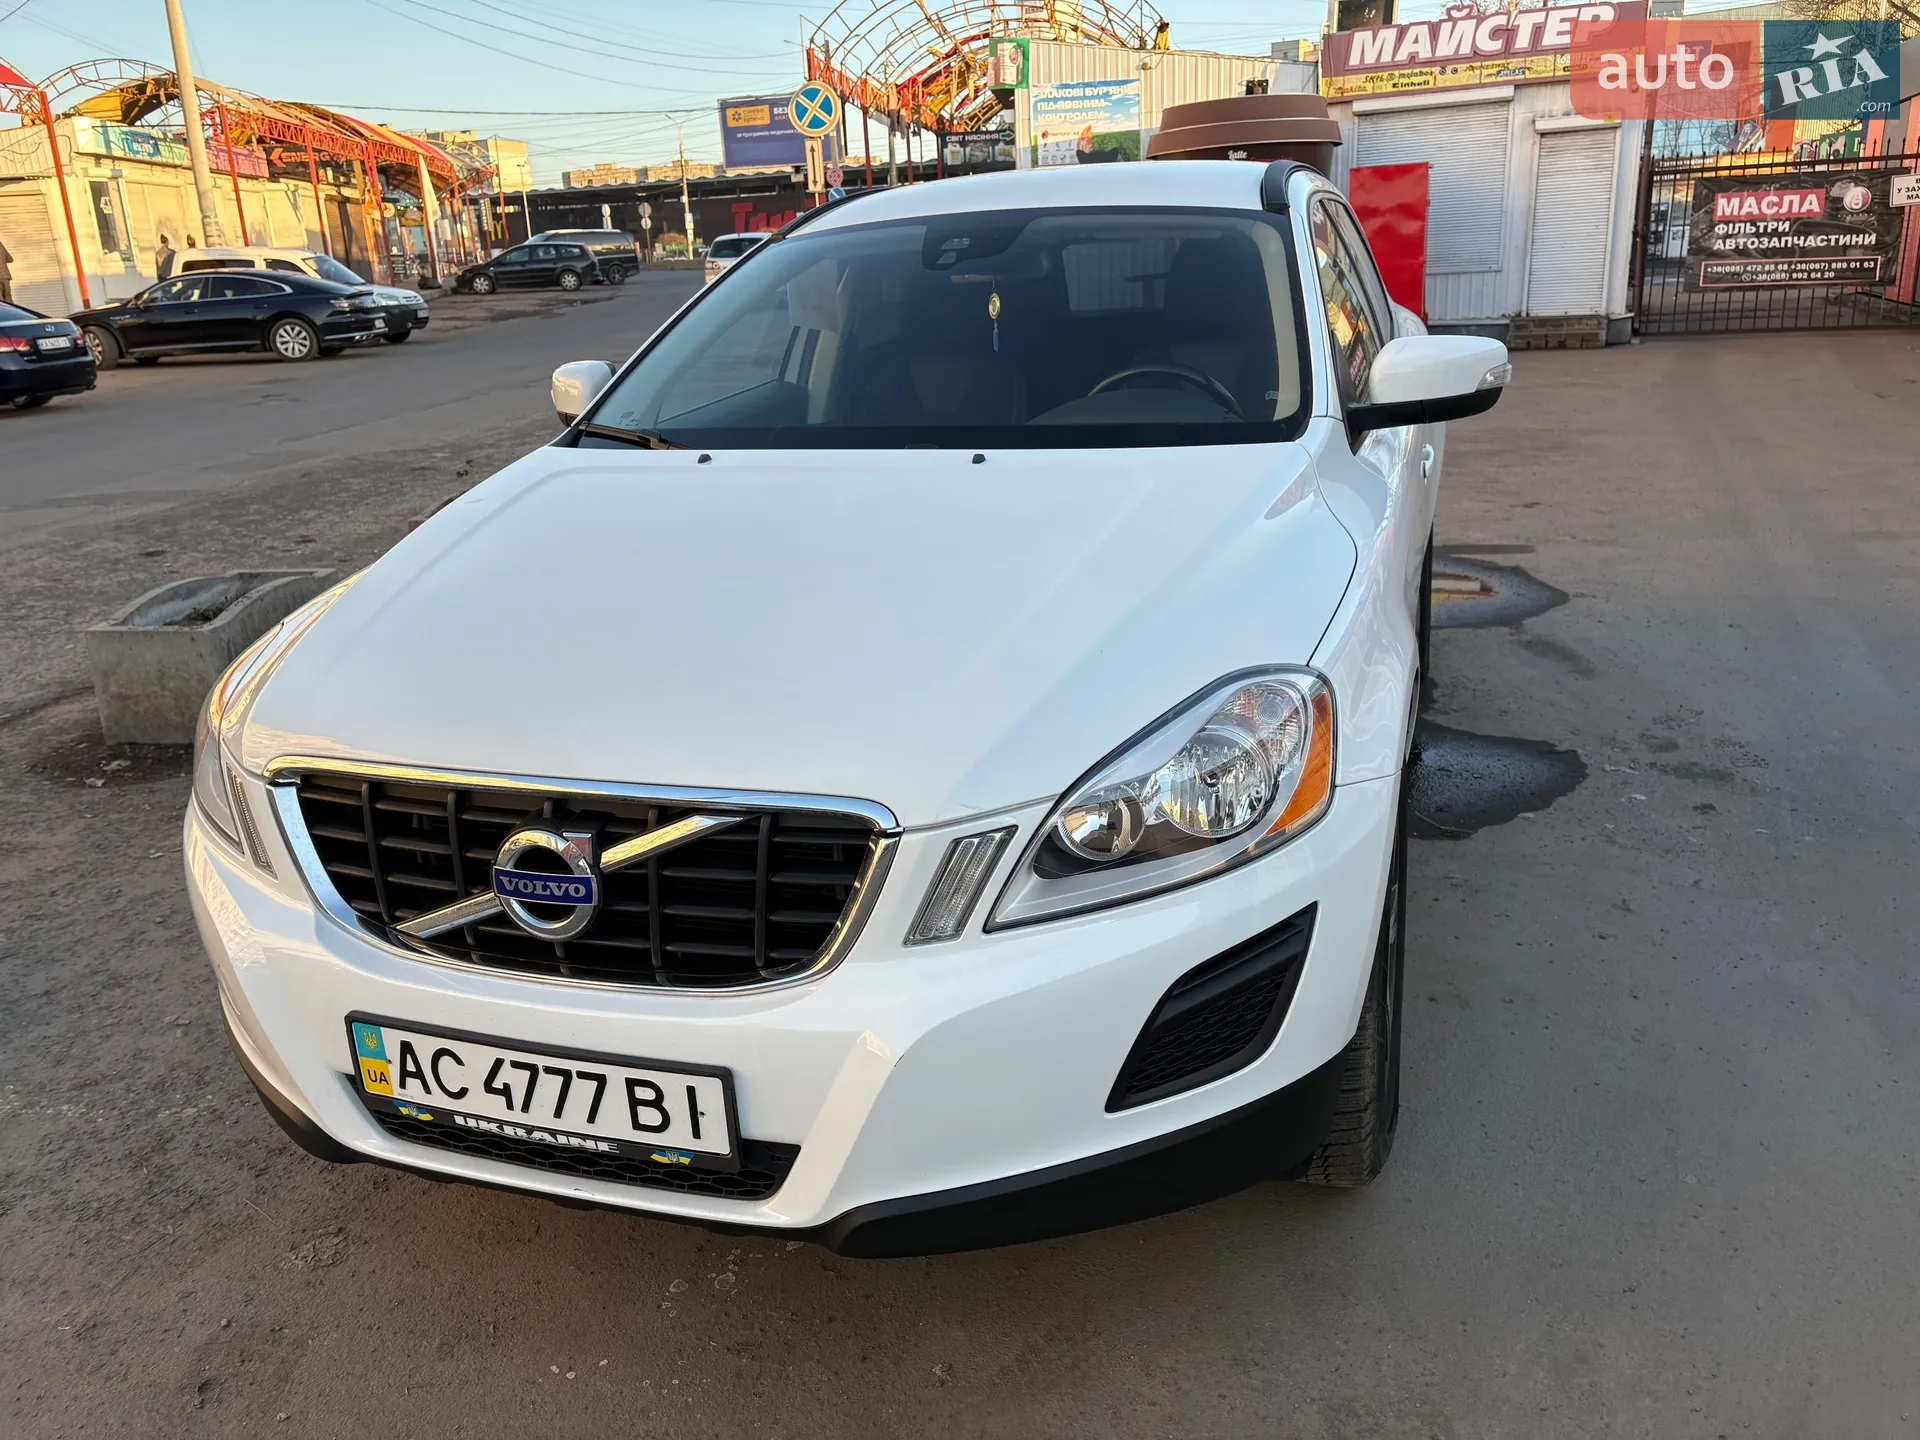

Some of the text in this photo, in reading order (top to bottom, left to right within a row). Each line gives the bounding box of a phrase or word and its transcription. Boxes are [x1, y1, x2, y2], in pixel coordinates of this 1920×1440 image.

[1348, 4, 1615, 66] МАЙСТЕР
[1391, 80, 1430, 89] Einhell
[1038, 110, 1105, 121] КОНТРОЛЕМ
[965, 133, 999, 141] НАСІННЯ
[1228, 150, 1248, 161] Latte
[1717, 193, 1821, 216] МАСЛА
[1714, 221, 1790, 235] ФІЛЬТРИ
[1713, 233, 1876, 250] АВТОЗАПЧАСТИНИ
[1746, 264, 1762, 272] 472
[499, 876, 586, 898] VOLVO
[367, 1069, 389, 1086] UA
[399, 1040, 701, 1140] AC 4777 BI
[453, 1115, 620, 1154] UKRAINE
